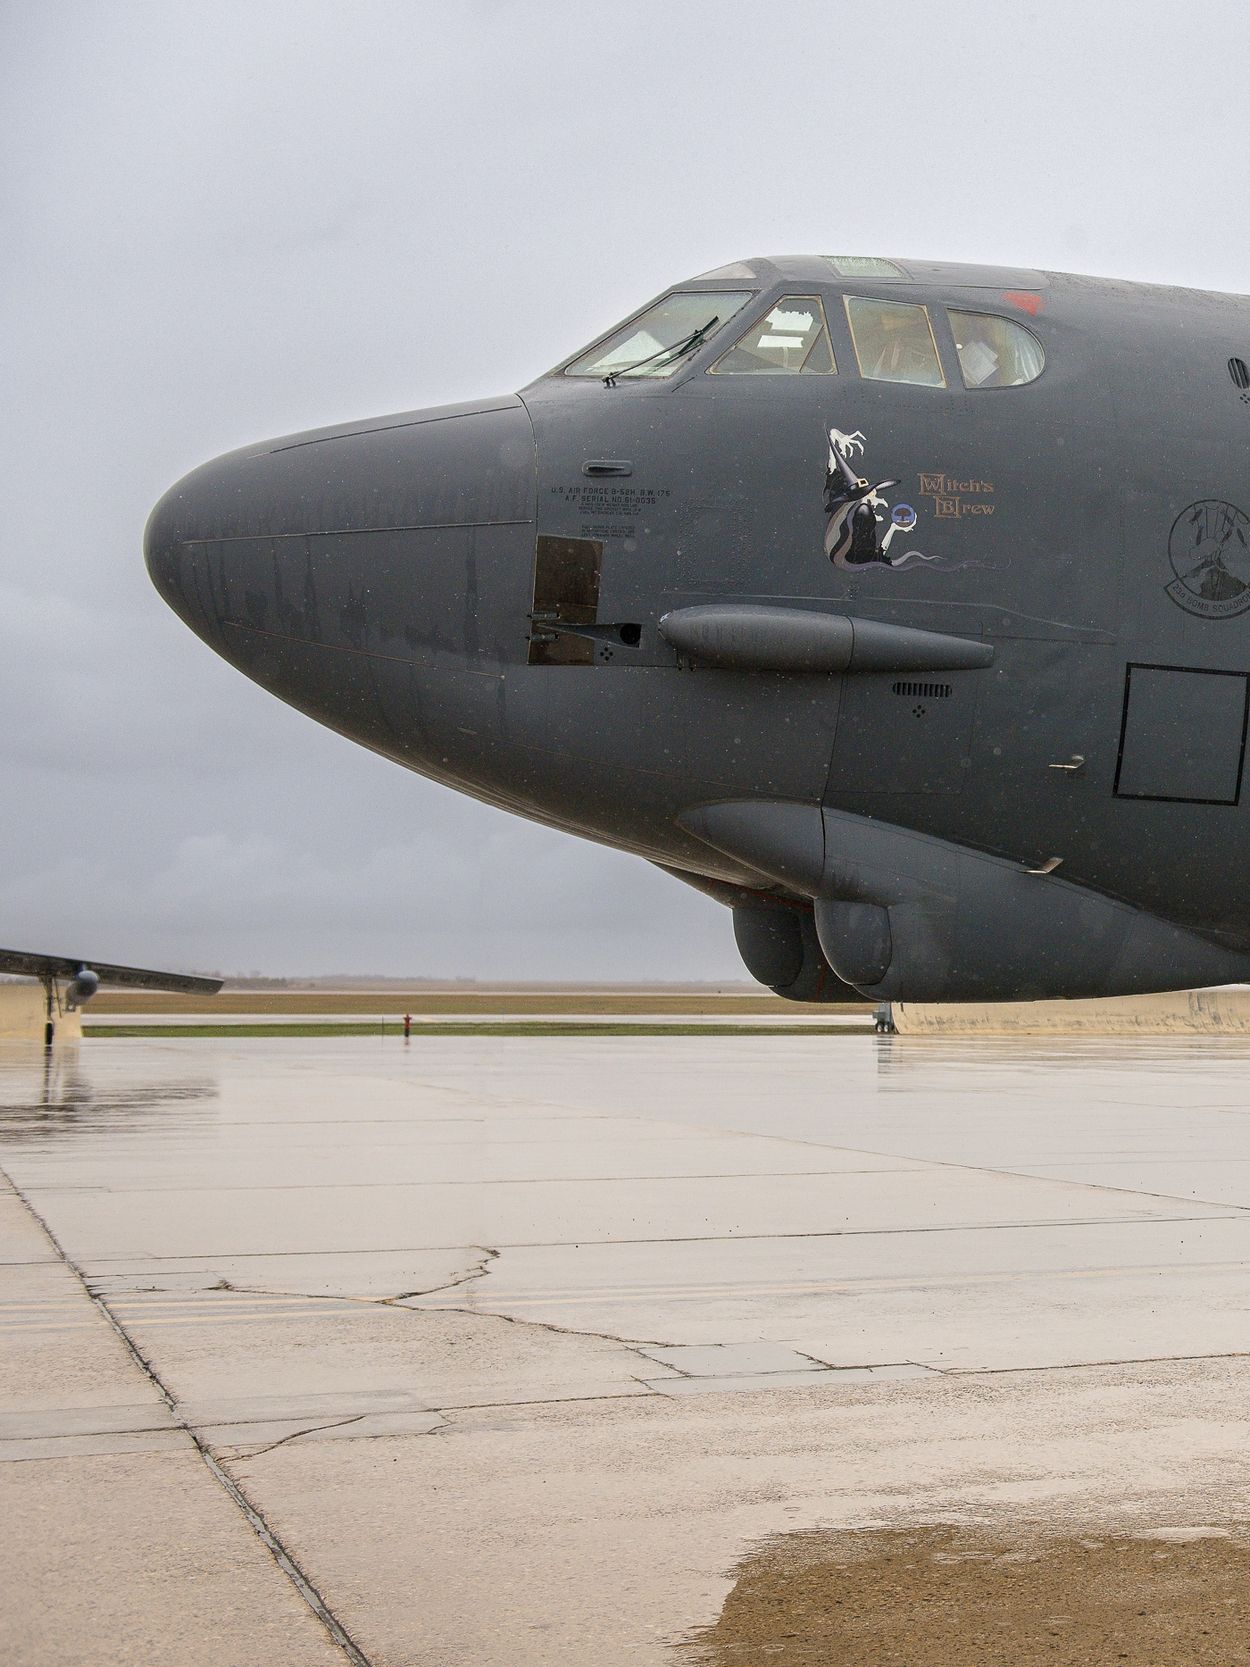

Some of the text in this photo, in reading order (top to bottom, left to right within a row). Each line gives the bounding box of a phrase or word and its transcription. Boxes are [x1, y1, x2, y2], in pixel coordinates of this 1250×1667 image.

[918, 473, 994, 495] Witch's
[581, 495, 610, 504] SERIAL
[934, 496, 995, 518] Brew
